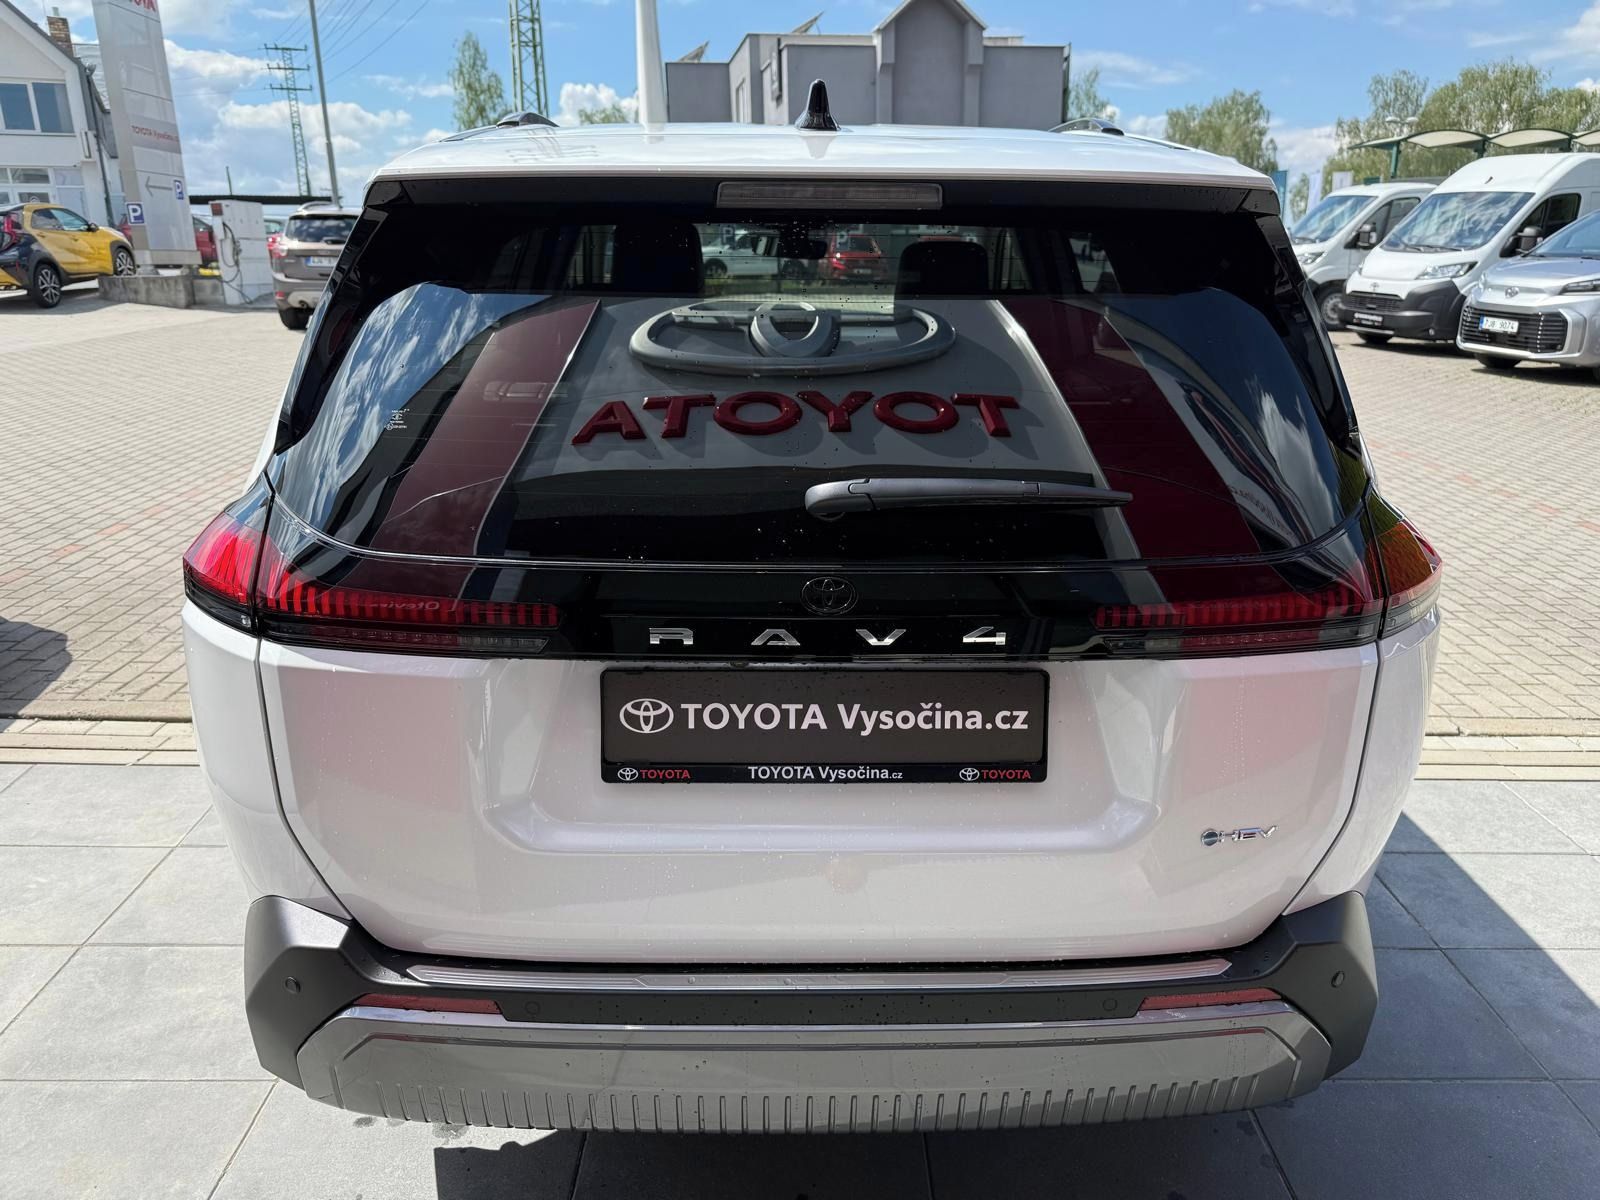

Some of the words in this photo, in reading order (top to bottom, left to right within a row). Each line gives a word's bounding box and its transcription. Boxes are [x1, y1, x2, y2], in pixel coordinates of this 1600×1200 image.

[128, 205, 142, 223] P
[648, 626, 1008, 646] RAV4
[681, 702, 827, 730] TOYOTA
[837, 701, 1029, 736] Vysočina.cz
[640, 769, 690, 780] TOYOTA
[748, 766, 814, 780] TOYOTA
[818, 765, 903, 782] Vysočina.cz
[982, 769, 1031, 780] TOYOTA
